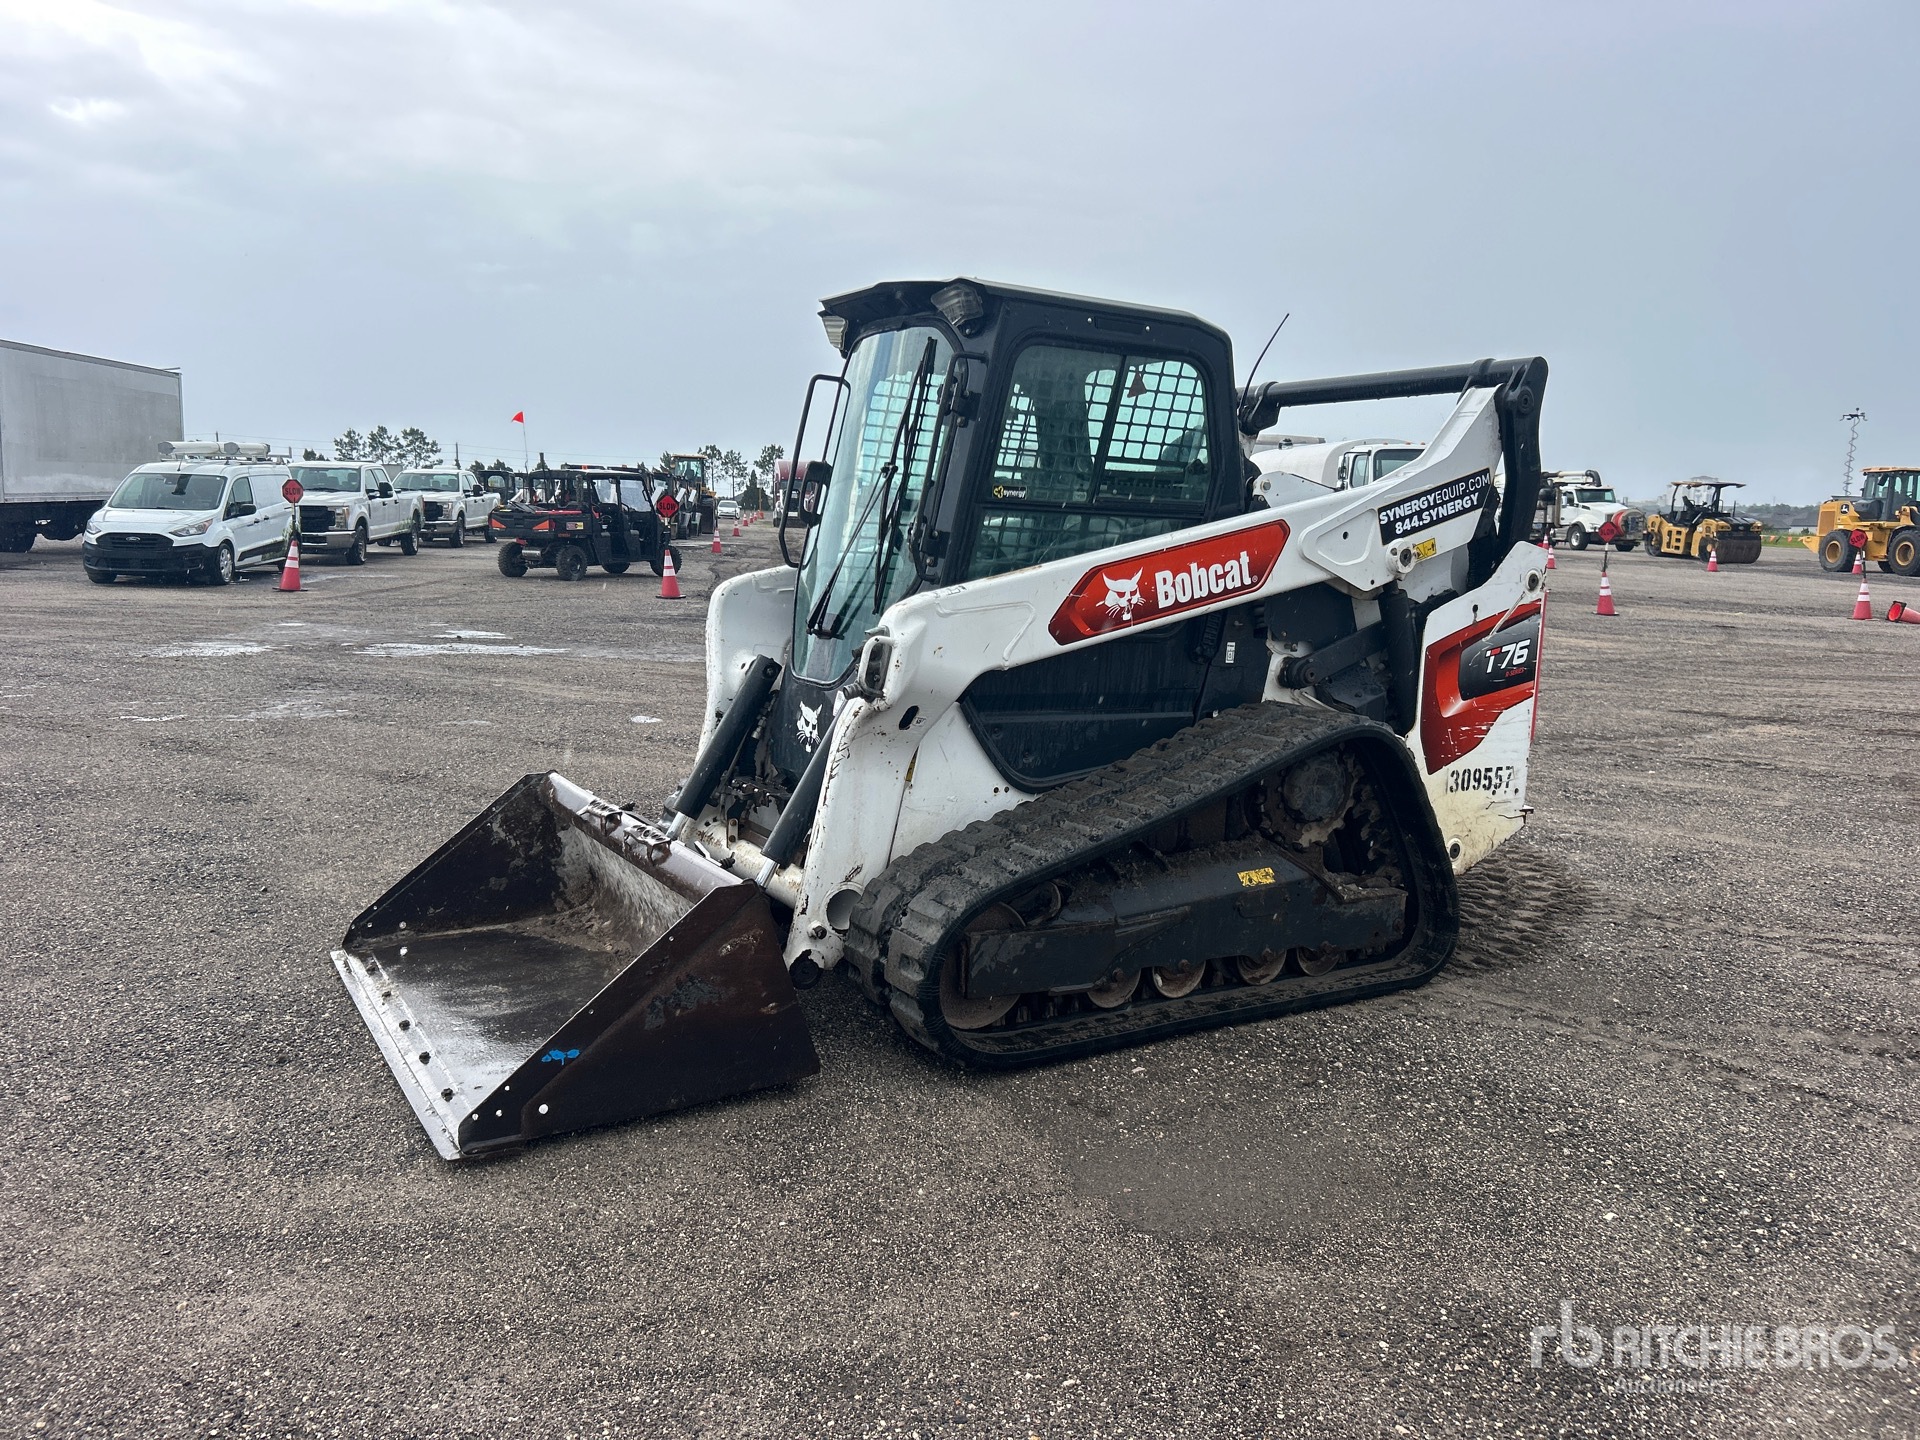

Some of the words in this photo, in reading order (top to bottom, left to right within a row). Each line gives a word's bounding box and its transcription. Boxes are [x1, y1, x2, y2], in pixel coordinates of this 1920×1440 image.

[284, 487, 301, 496] SLOW
[659, 502, 677, 511] SLOW
[1380, 473, 1490, 525] SYNERGYEQUIP.COM
[1395, 492, 1479, 535] 844.SYNERGY
[1851, 533, 1865, 544] SLOW
[1154, 550, 1252, 609] Bobcat
[1485, 639, 1531, 674] T76
[1449, 765, 1514, 793] 309557
